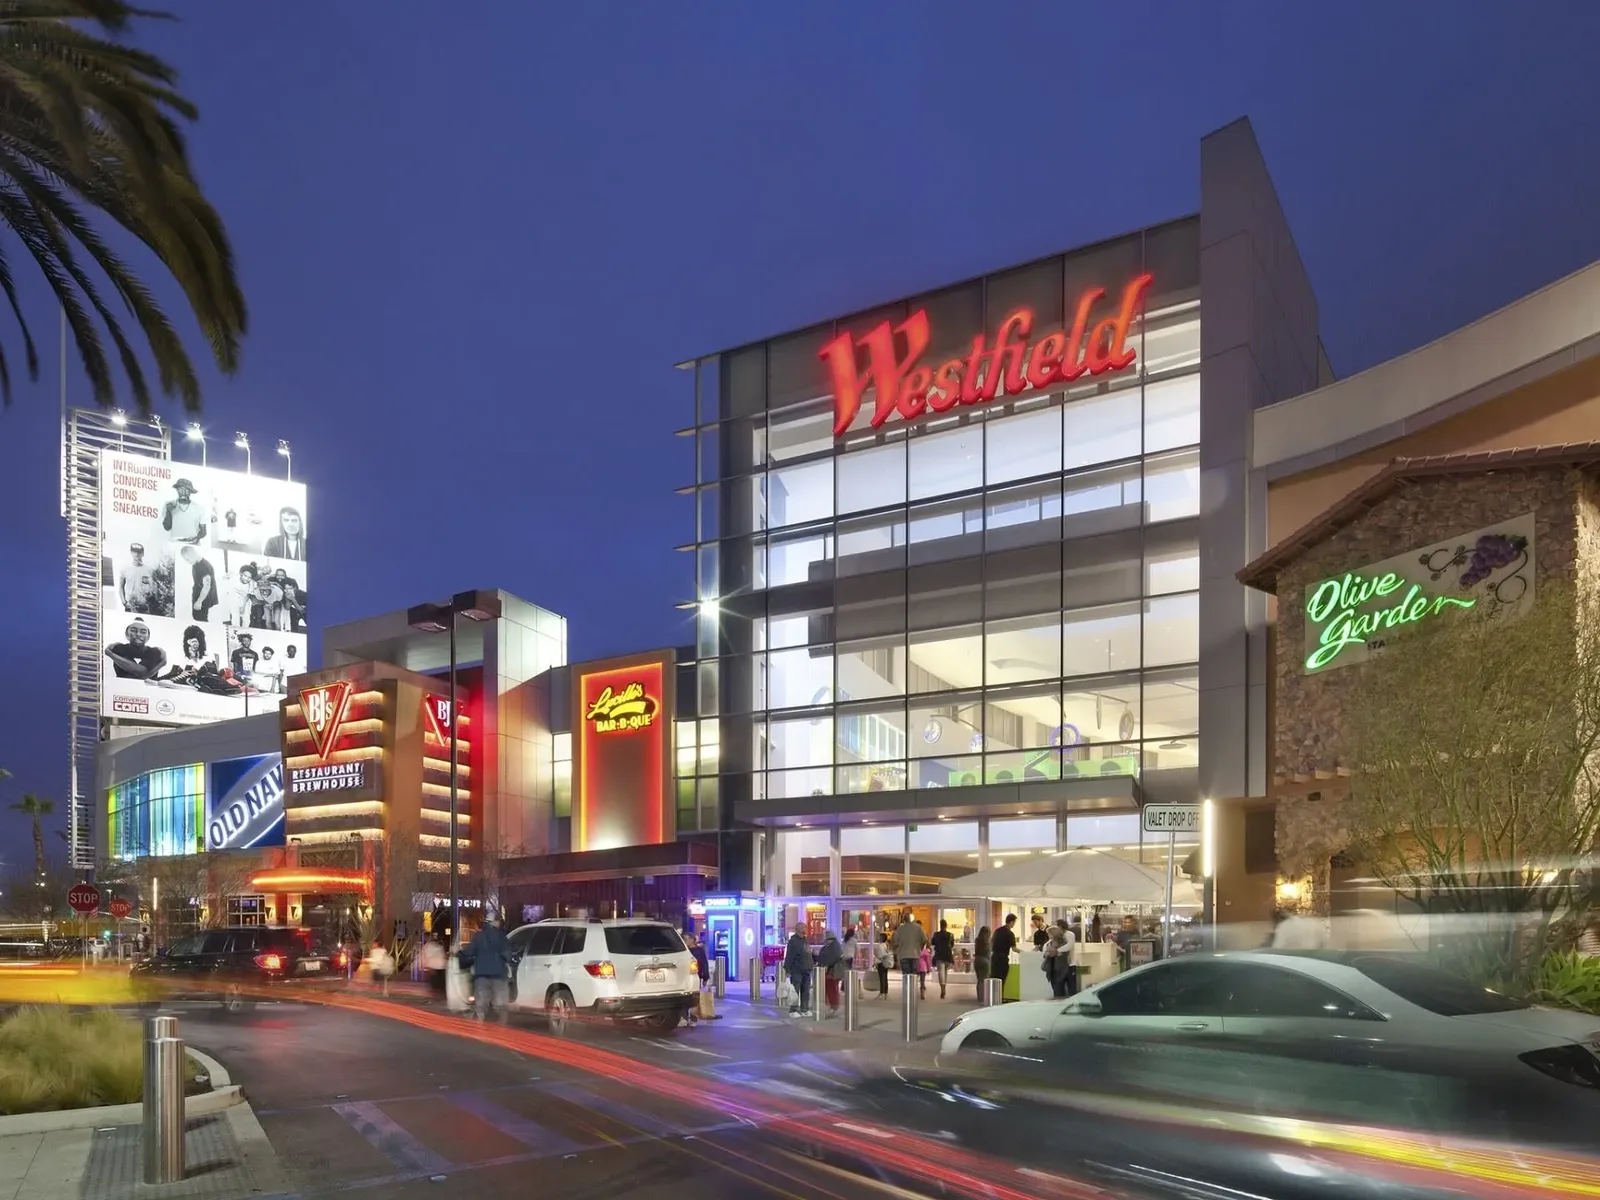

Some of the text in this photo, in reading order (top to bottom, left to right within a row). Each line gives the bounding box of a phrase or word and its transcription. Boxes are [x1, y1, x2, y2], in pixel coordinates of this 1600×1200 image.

[818, 273, 1153, 437] Westfield
[113, 459, 171, 480] INTRODUCING
[113, 473, 158, 491] CONVERSE
[113, 487, 137, 502] CONS
[113, 501, 159, 519] SNEAKERS
[1306, 573, 1405, 622] Olive
[1306, 584, 1477, 669] Garden
[308, 689, 334, 732] BJ's
[292, 763, 361, 780] RESTAURANT
[292, 776, 361, 793] BREWHOUSE
[209, 763, 284, 848] OLD NAV
[1148, 812, 1200, 826] VALET DROP OFF
[70, 893, 98, 904] STOP
[110, 903, 130, 912] STOP
